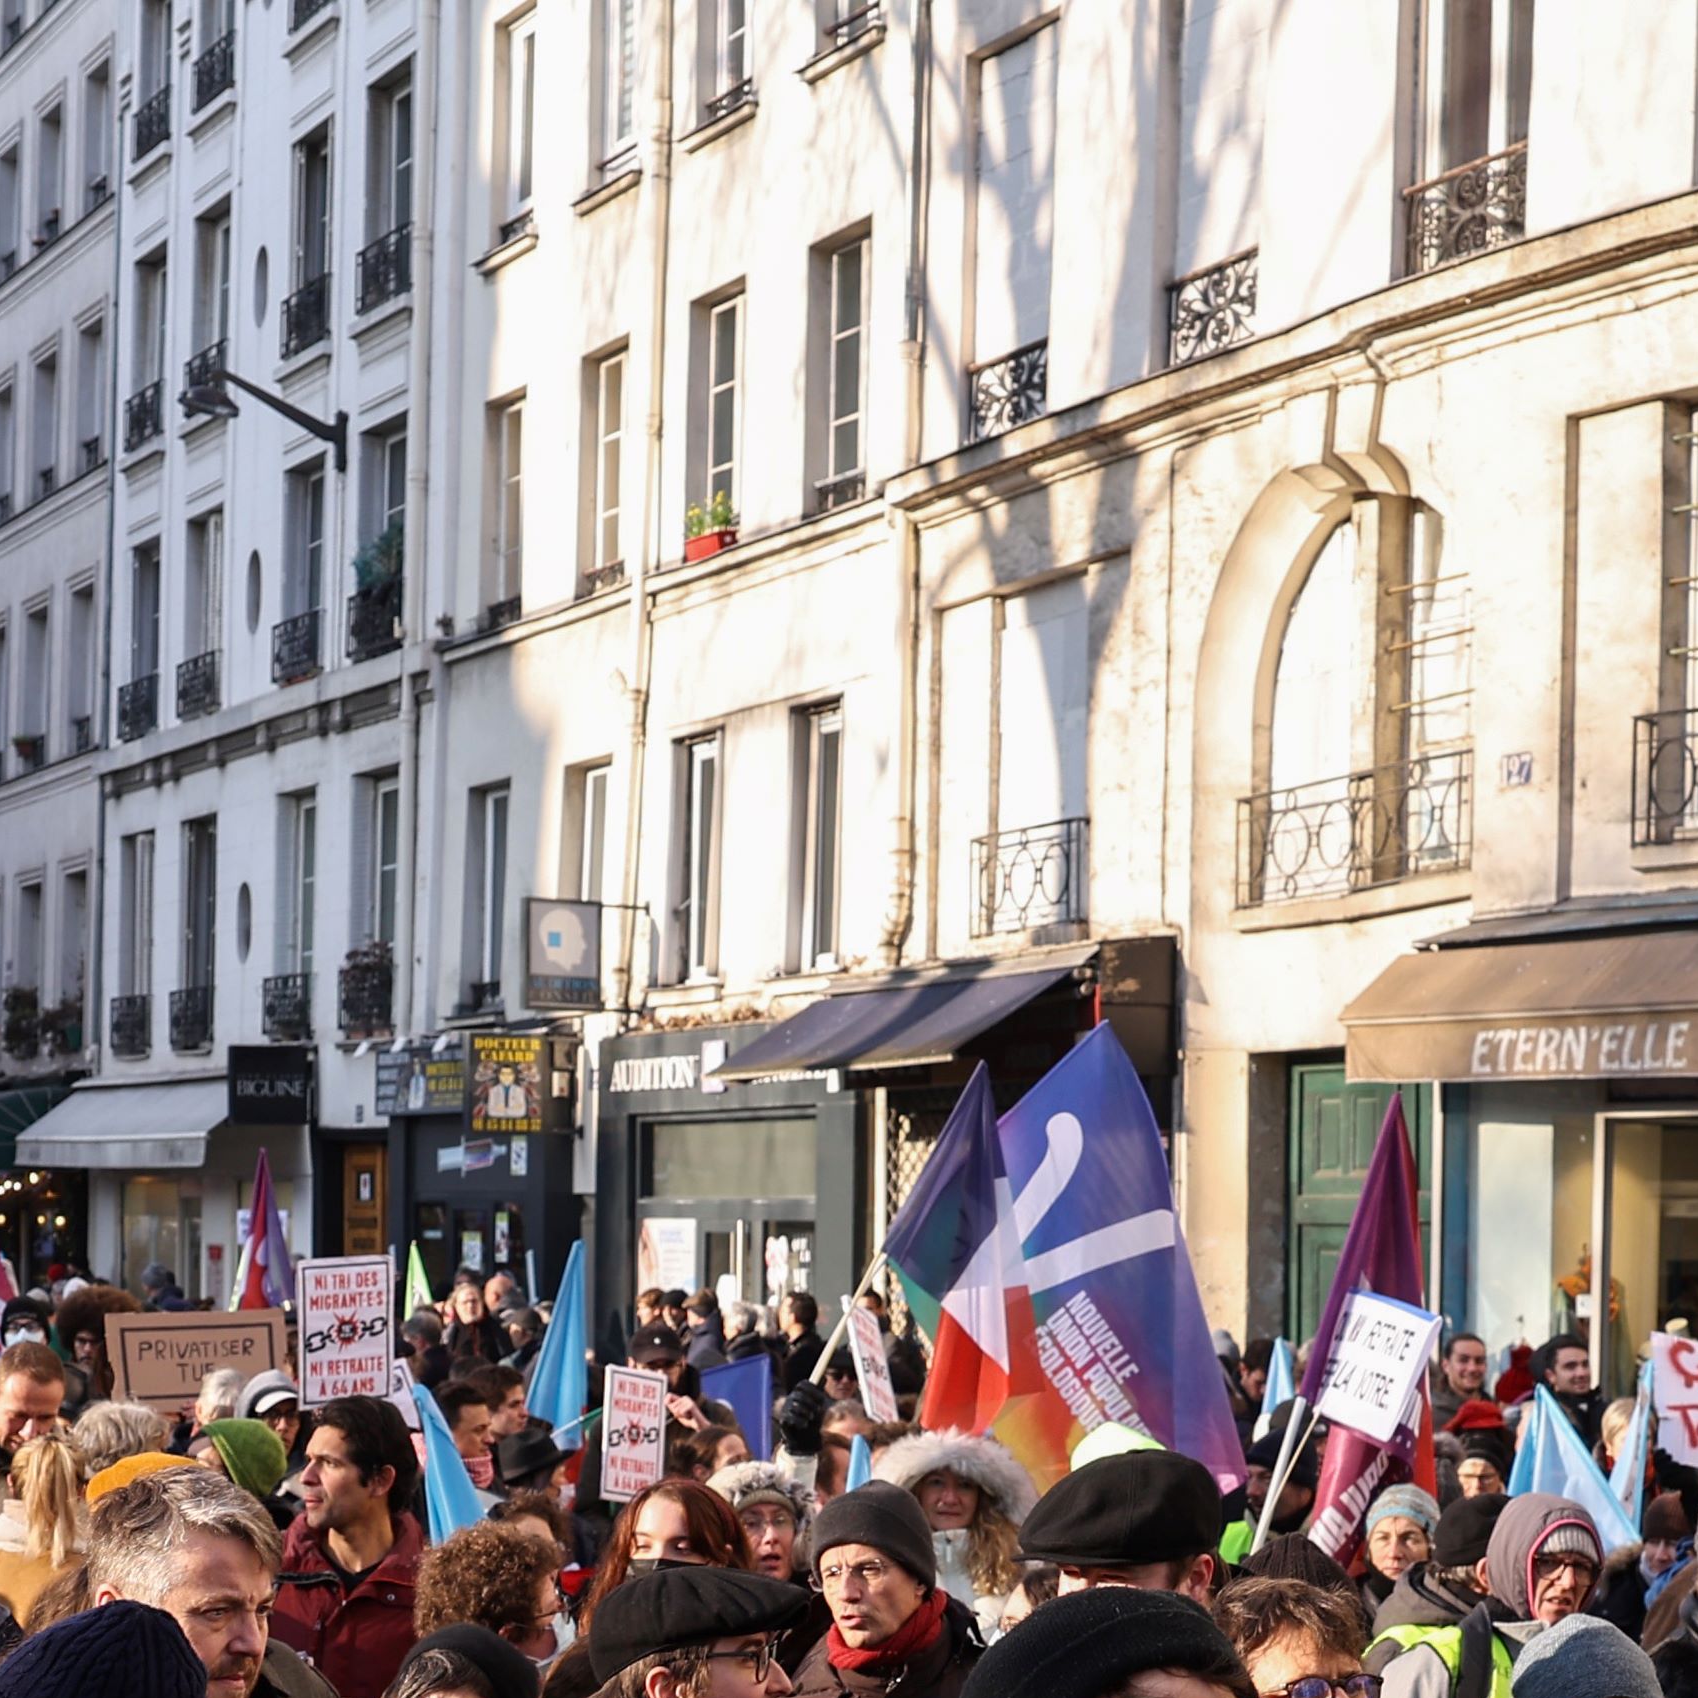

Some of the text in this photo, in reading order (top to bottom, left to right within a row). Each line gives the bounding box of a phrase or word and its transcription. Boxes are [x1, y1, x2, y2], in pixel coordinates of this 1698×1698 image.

[474, 1037, 541, 1050] DOCTEUR
[1471, 1021, 1690, 1074] ETERN'ELLE
[480, 1050, 535, 1062] CAFARD
[610, 1056, 694, 1092] AUDITION
[237, 1080, 304, 1097] BIGUINE
[314, 1271, 378, 1291] NI TRI DES
[1046, 1306, 1095, 1370] UNION
[1066, 1290, 1140, 1385] NOUVELLE
[138, 1337, 255, 1361] PRIVATISER
[310, 1356, 383, 1377] NI RETRAITE
[331, 1380, 348, 1396] 64
[352, 1378, 374, 1397] ANS
